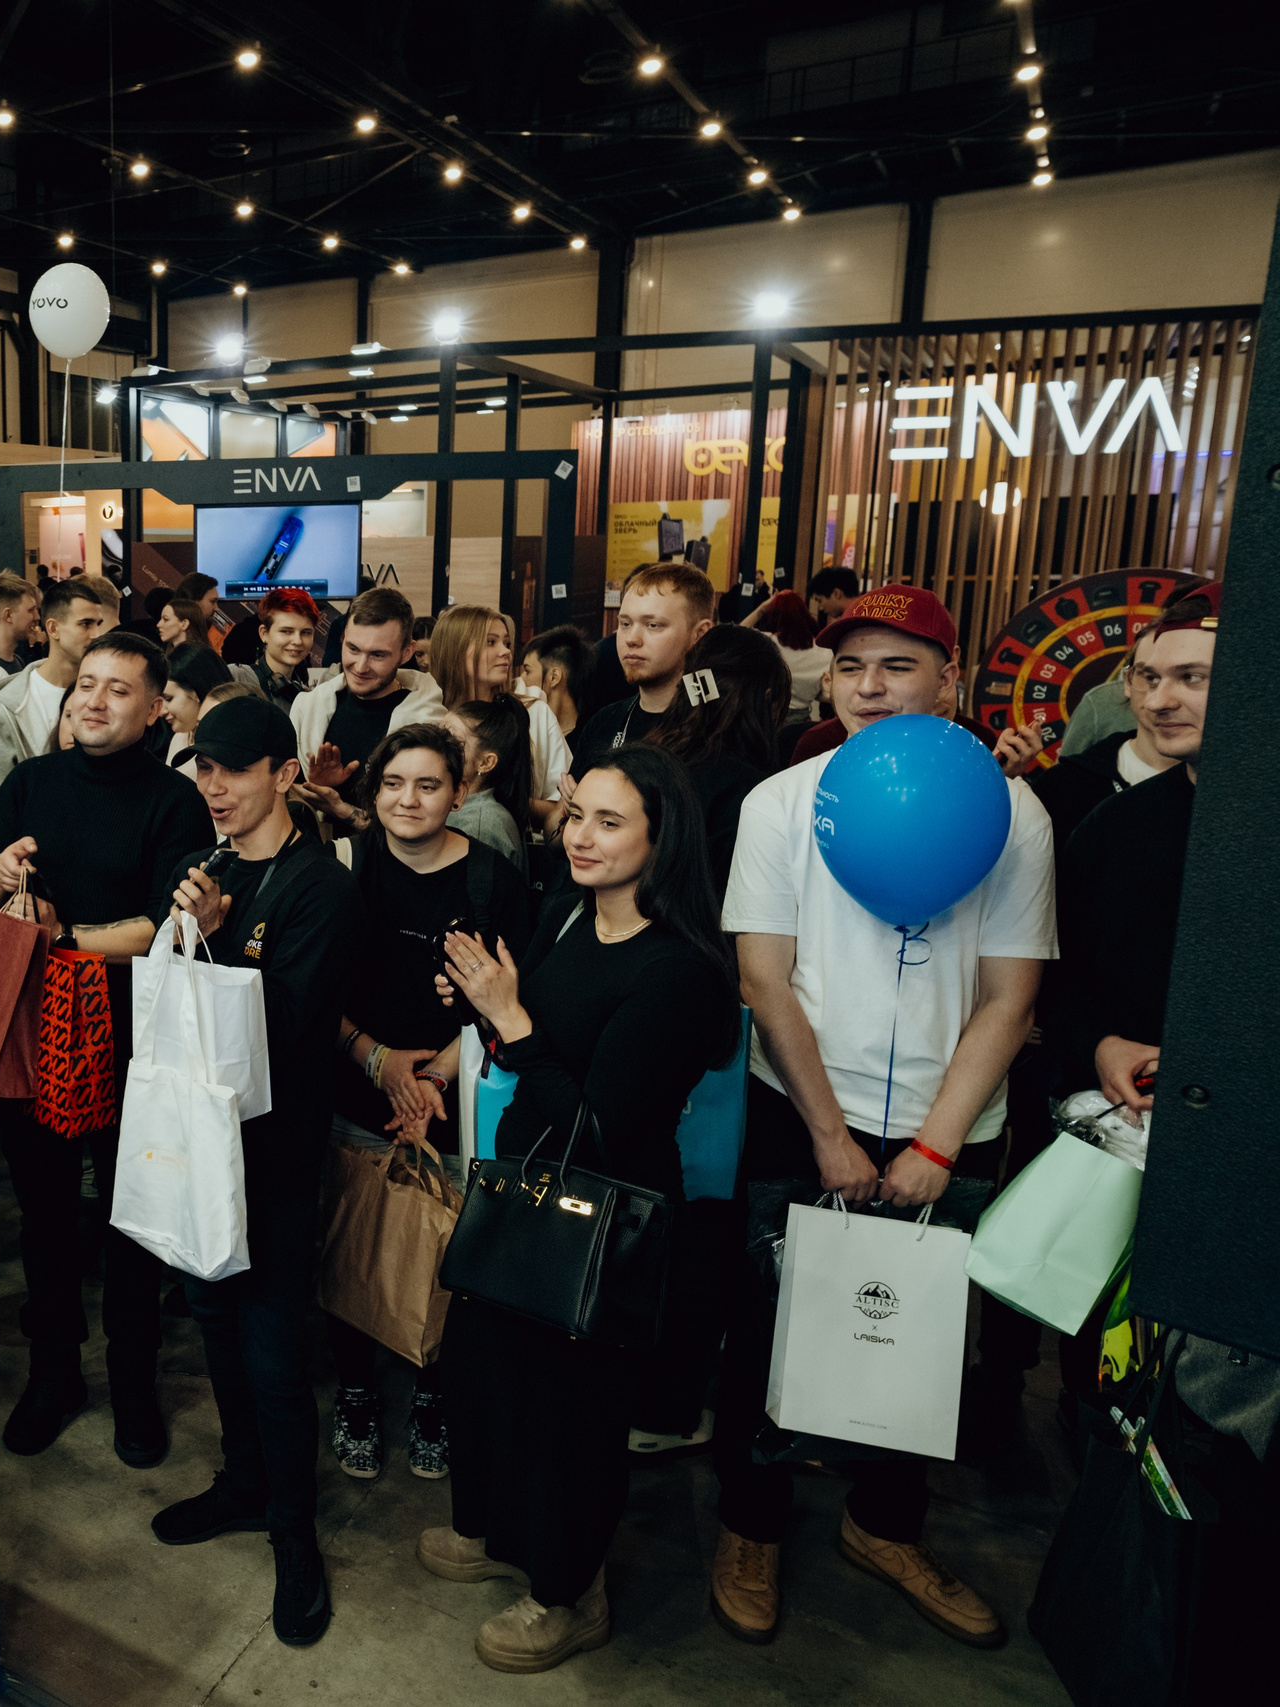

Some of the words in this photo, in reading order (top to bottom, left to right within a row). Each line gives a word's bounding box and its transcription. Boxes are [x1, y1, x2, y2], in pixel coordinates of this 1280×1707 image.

[890, 376, 1184, 461] ENVA
[233, 466, 322, 494] ENVA
[361, 562, 400, 586] VA
[1076, 631, 1096, 646] 05
[1104, 624, 1122, 637] 06
[1054, 645, 1074, 661] 04
[1039, 663, 1056, 679] 03
[1032, 684, 1047, 699] 02
[1041, 726, 1057, 742] 20
[855, 1296, 899, 1309] ALTISC
[853, 1332, 895, 1346] LAISKA
